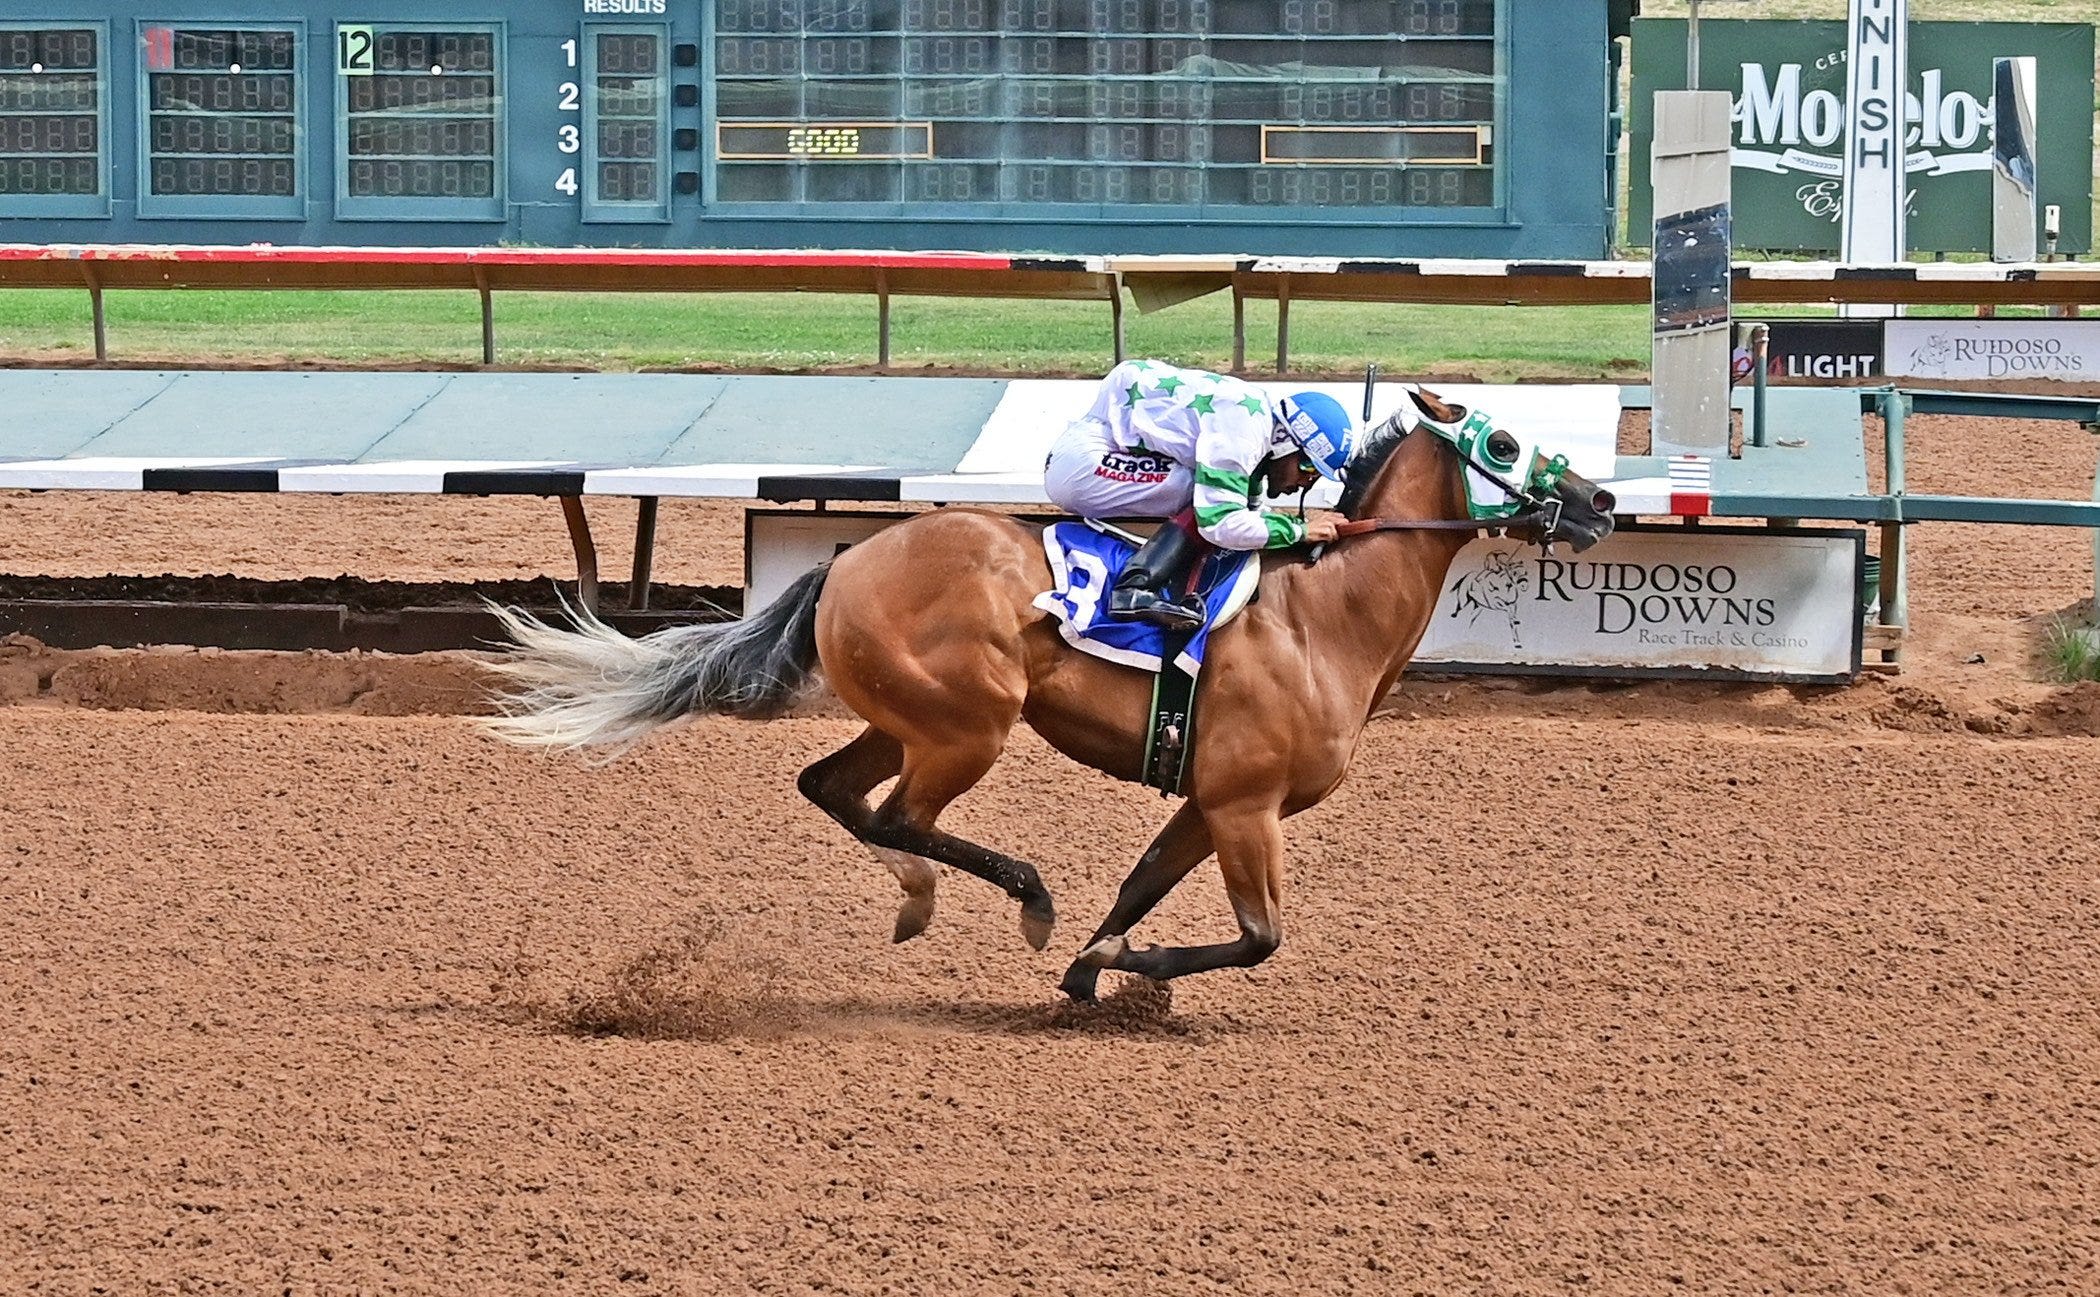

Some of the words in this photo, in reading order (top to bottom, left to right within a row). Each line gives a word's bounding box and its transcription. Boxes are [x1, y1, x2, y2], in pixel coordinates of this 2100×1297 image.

[584, 0, 667, 14] RESULTS
[339, 30, 371, 69] 12
[561, 39, 577, 68] 1
[558, 82, 580, 111] 2
[1859, 0, 1890, 169] NISH
[558, 124, 580, 154] 3
[787, 129, 859, 153] GOOD
[555, 168, 579, 196] 4
[1788, 354, 1875, 378] LIGHT
[1094, 466, 1170, 483] MAGAZINE
[1101, 452, 1174, 473] track
[1535, 558, 1737, 602] RUIDOSO
[1594, 591, 1776, 634] DOWNS
[1638, 628, 1678, 645] Race
[1682, 629, 1726, 647] Track
[1730, 633, 1748, 647] &
[1752, 632, 1809, 649] Casino
